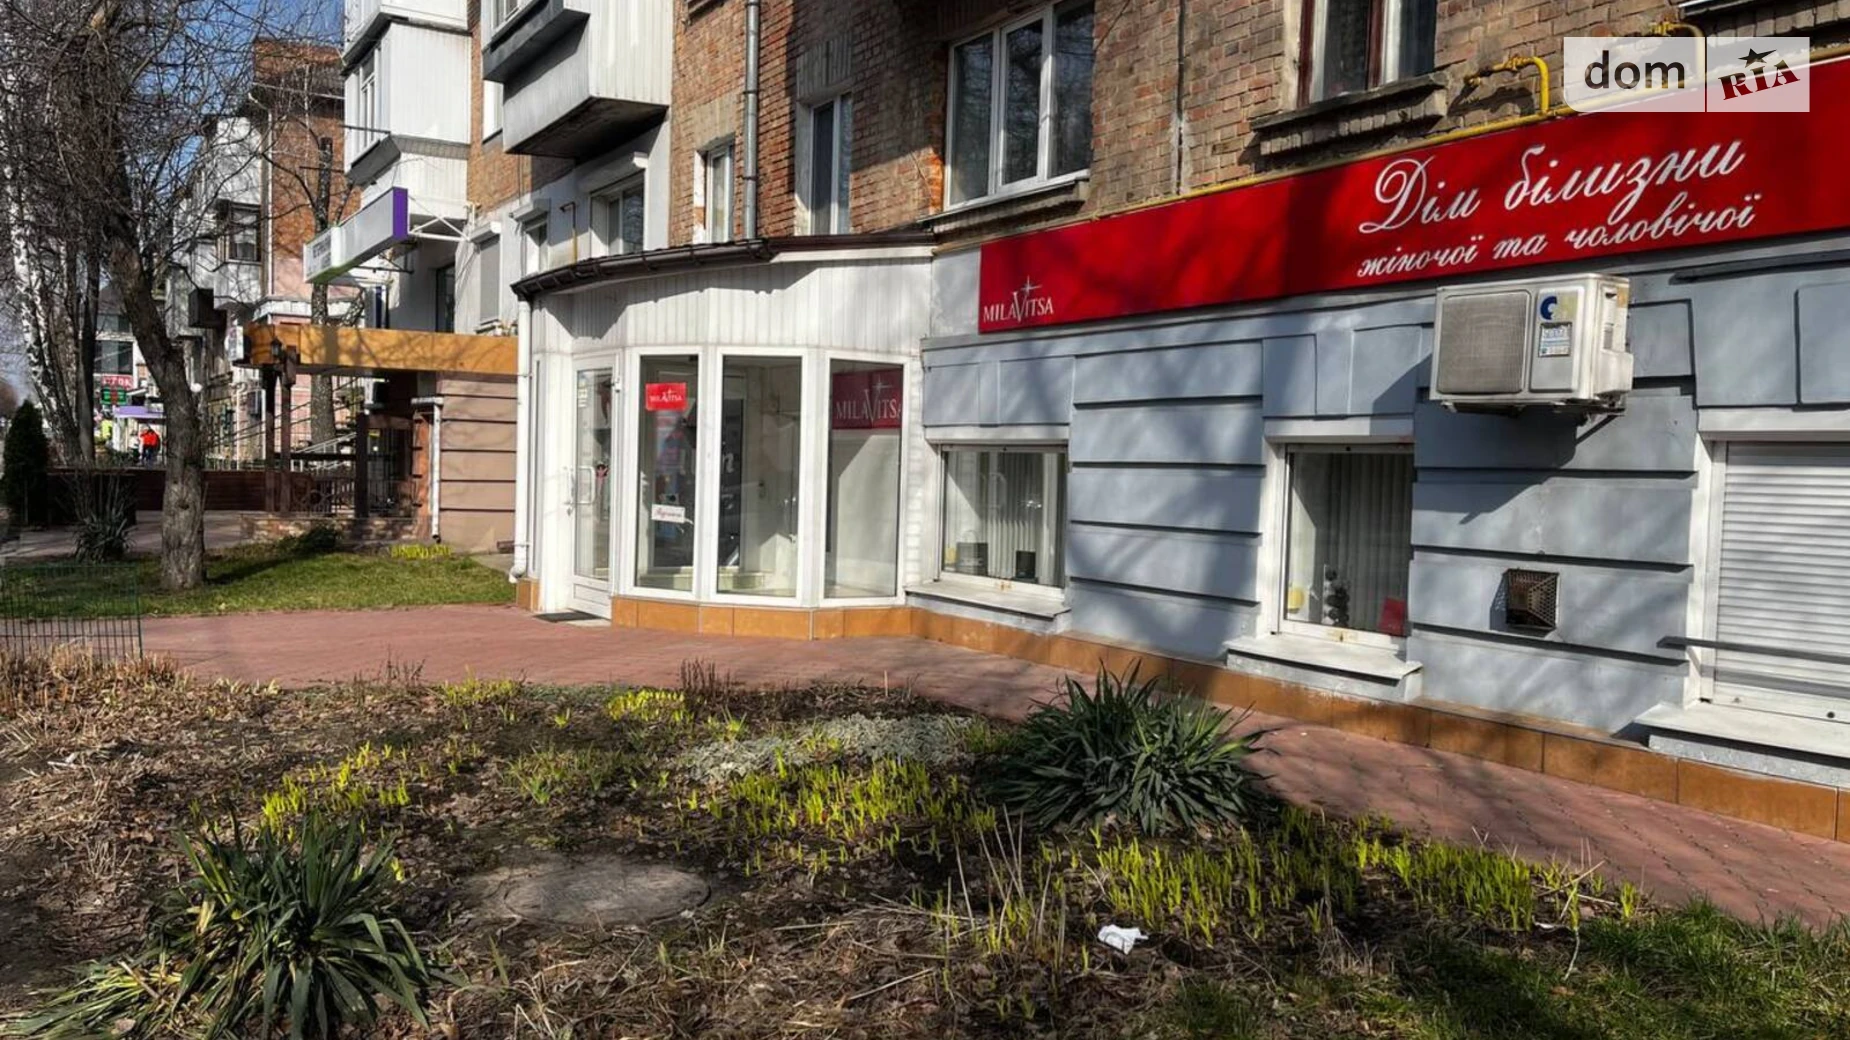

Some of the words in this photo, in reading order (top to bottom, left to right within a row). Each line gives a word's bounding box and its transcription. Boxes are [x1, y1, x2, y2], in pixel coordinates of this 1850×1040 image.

[1359, 155, 1481, 233] Дім
[1504, 140, 1746, 225] білизни
[1357, 235, 1484, 278] жіночої
[1493, 233, 1548, 260] та
[1564, 192, 1761, 250] чоловічої
[983, 290, 1054, 322] MILAVITSA
